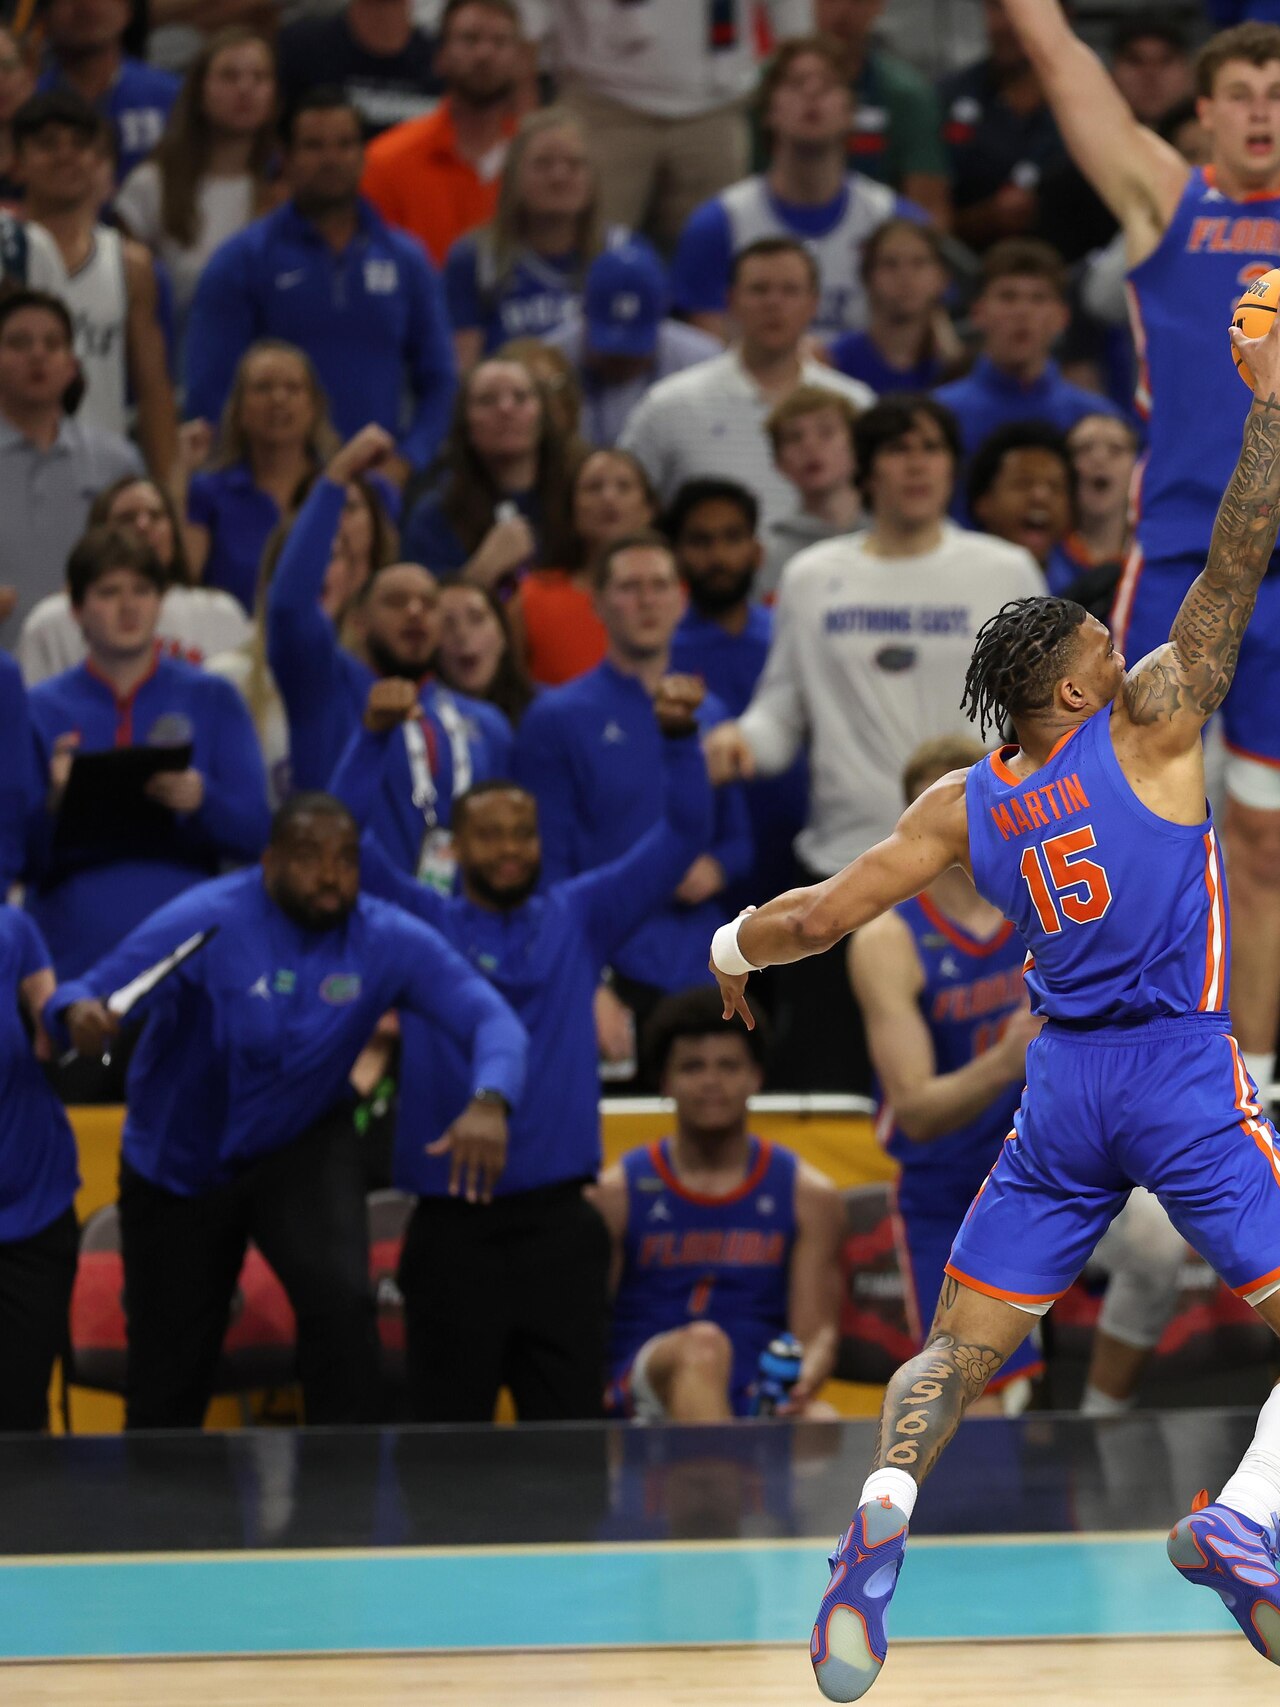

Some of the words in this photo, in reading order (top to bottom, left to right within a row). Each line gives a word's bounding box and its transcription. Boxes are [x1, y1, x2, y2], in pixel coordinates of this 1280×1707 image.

[990, 773, 1091, 841] MARTIN
[1020, 824, 1112, 935] 15
[640, 1231, 785, 1267] FLORIDA
